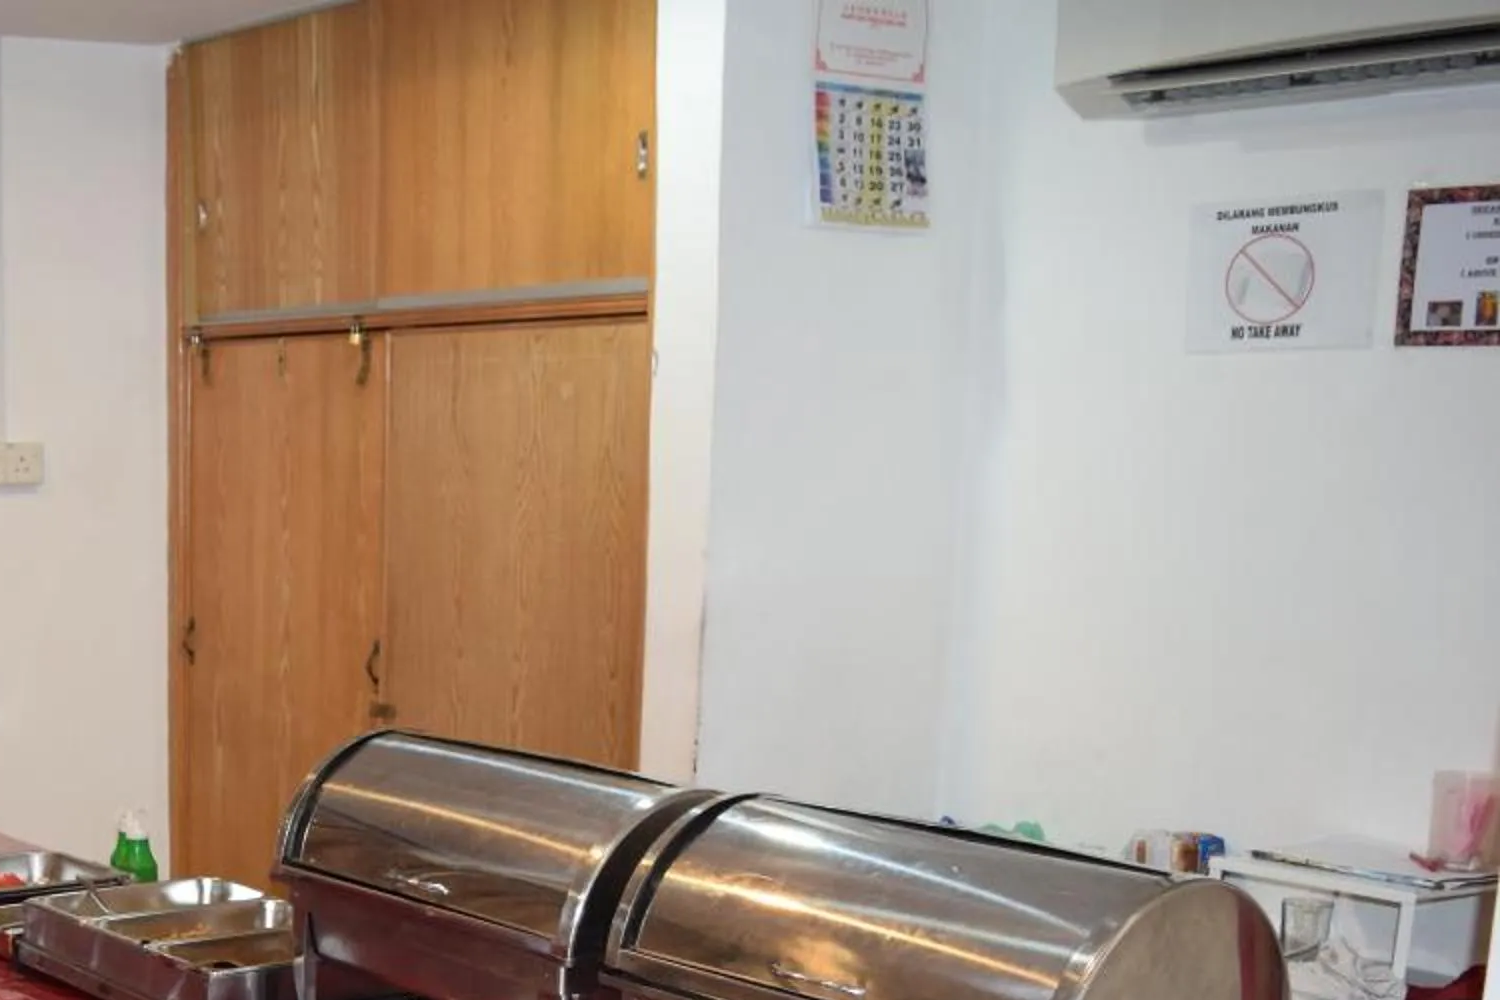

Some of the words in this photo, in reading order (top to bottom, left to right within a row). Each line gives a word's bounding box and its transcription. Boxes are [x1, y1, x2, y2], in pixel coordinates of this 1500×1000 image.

[1251, 222, 1300, 235] MAKANAN
[1231, 326, 1245, 340] NO
[1248, 325, 1271, 339] TAKE
[1274, 324, 1302, 337] AWAY
